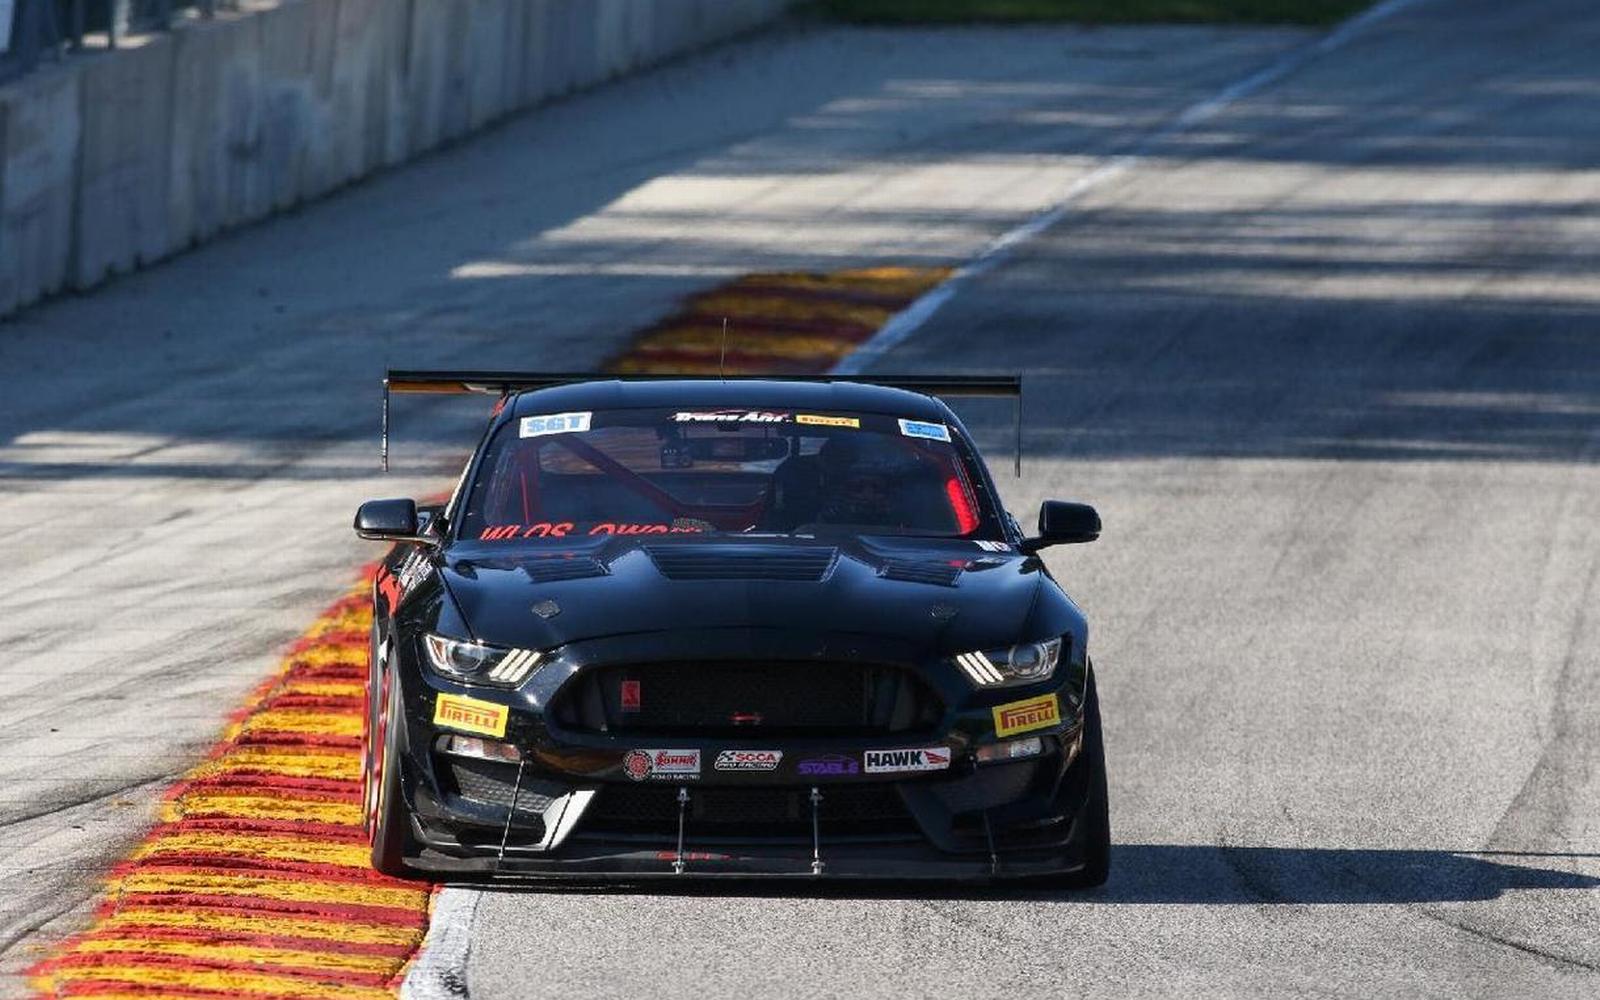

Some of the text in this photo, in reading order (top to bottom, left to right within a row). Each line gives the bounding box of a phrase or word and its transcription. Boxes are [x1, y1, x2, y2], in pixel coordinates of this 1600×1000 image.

[526, 415, 586, 433] SGT
[439, 699, 500, 730] PIRELLI
[1000, 700, 1055, 730] PIRELLI
[735, 753, 777, 762] SCCA
[866, 750, 923, 767] HAWK
